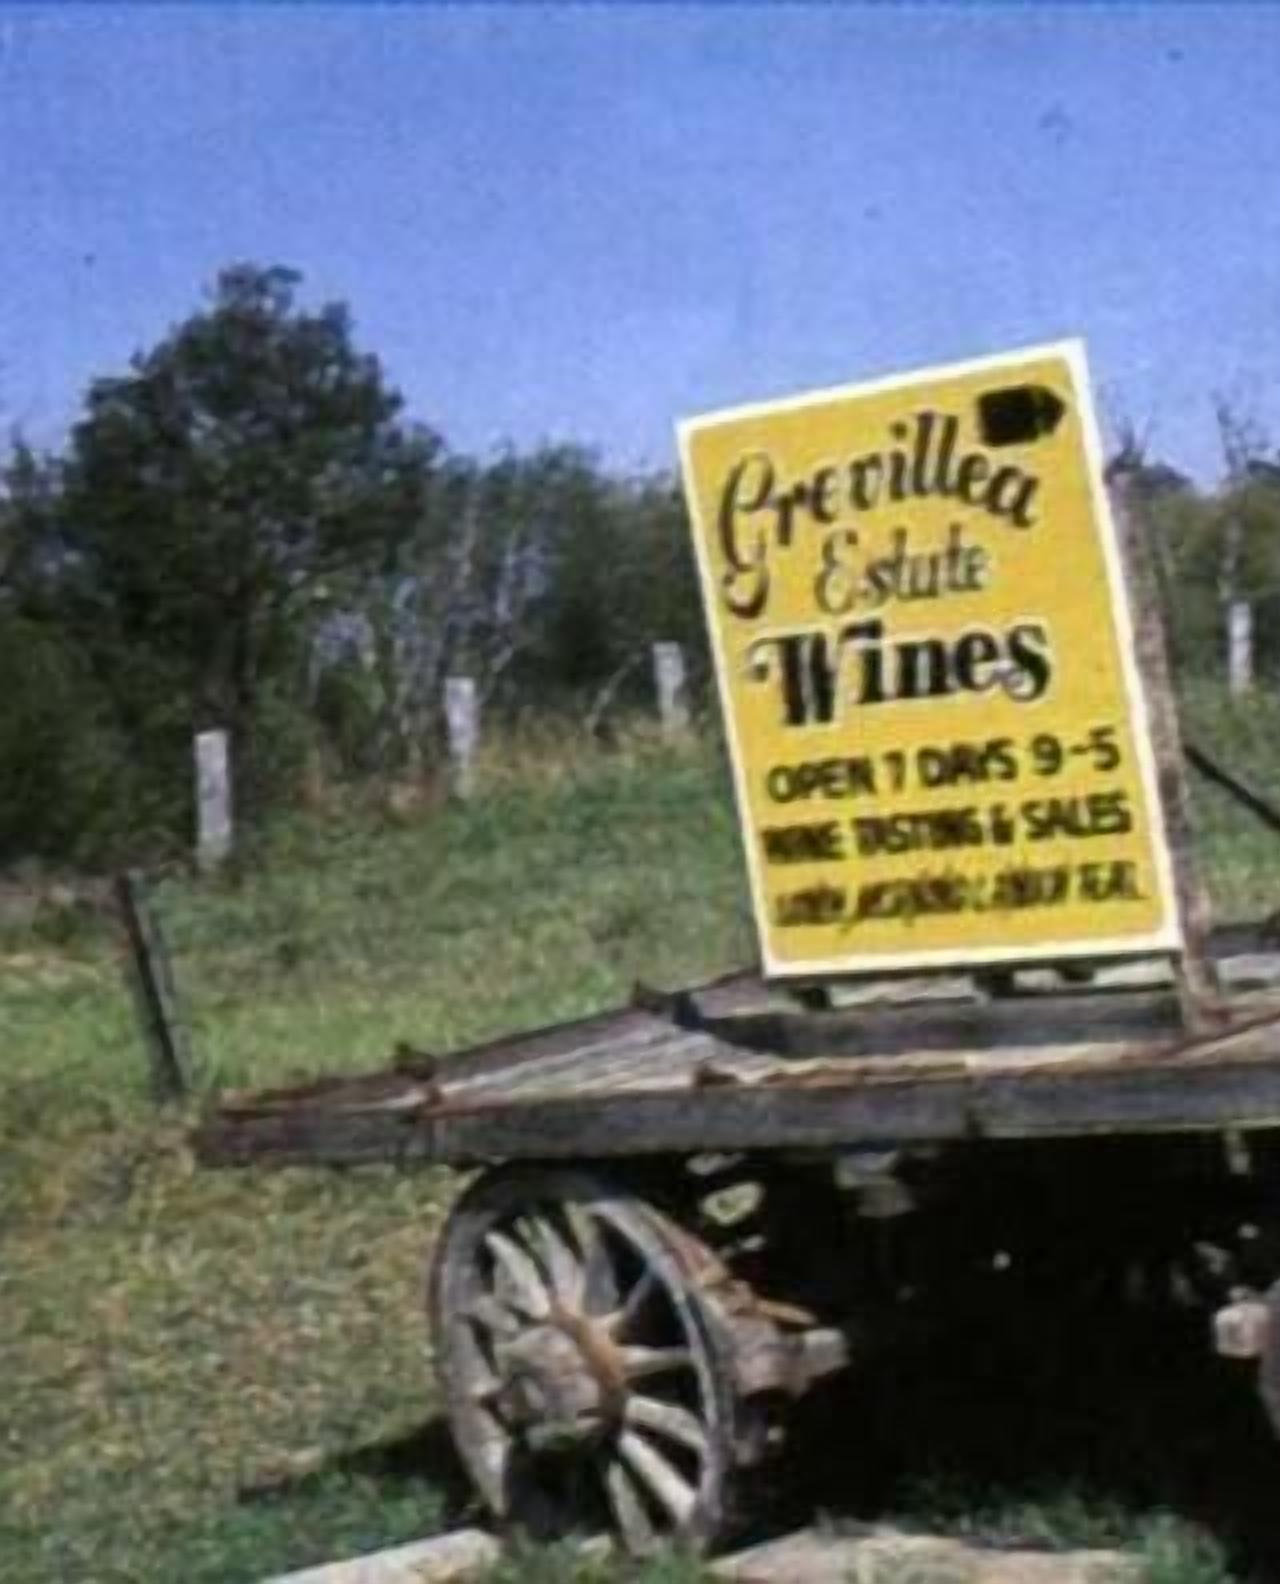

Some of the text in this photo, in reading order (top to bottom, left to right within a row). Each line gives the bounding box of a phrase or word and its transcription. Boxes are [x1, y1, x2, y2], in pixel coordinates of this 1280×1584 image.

[720, 411, 1038, 617] Grevillea
[817, 524, 986, 614] Estate
[751, 621, 1048, 725] Wines
[767, 755, 875, 803] OPEN
[917, 738, 1017, 788] DAYS
[1021, 790, 1131, 841] SALES
